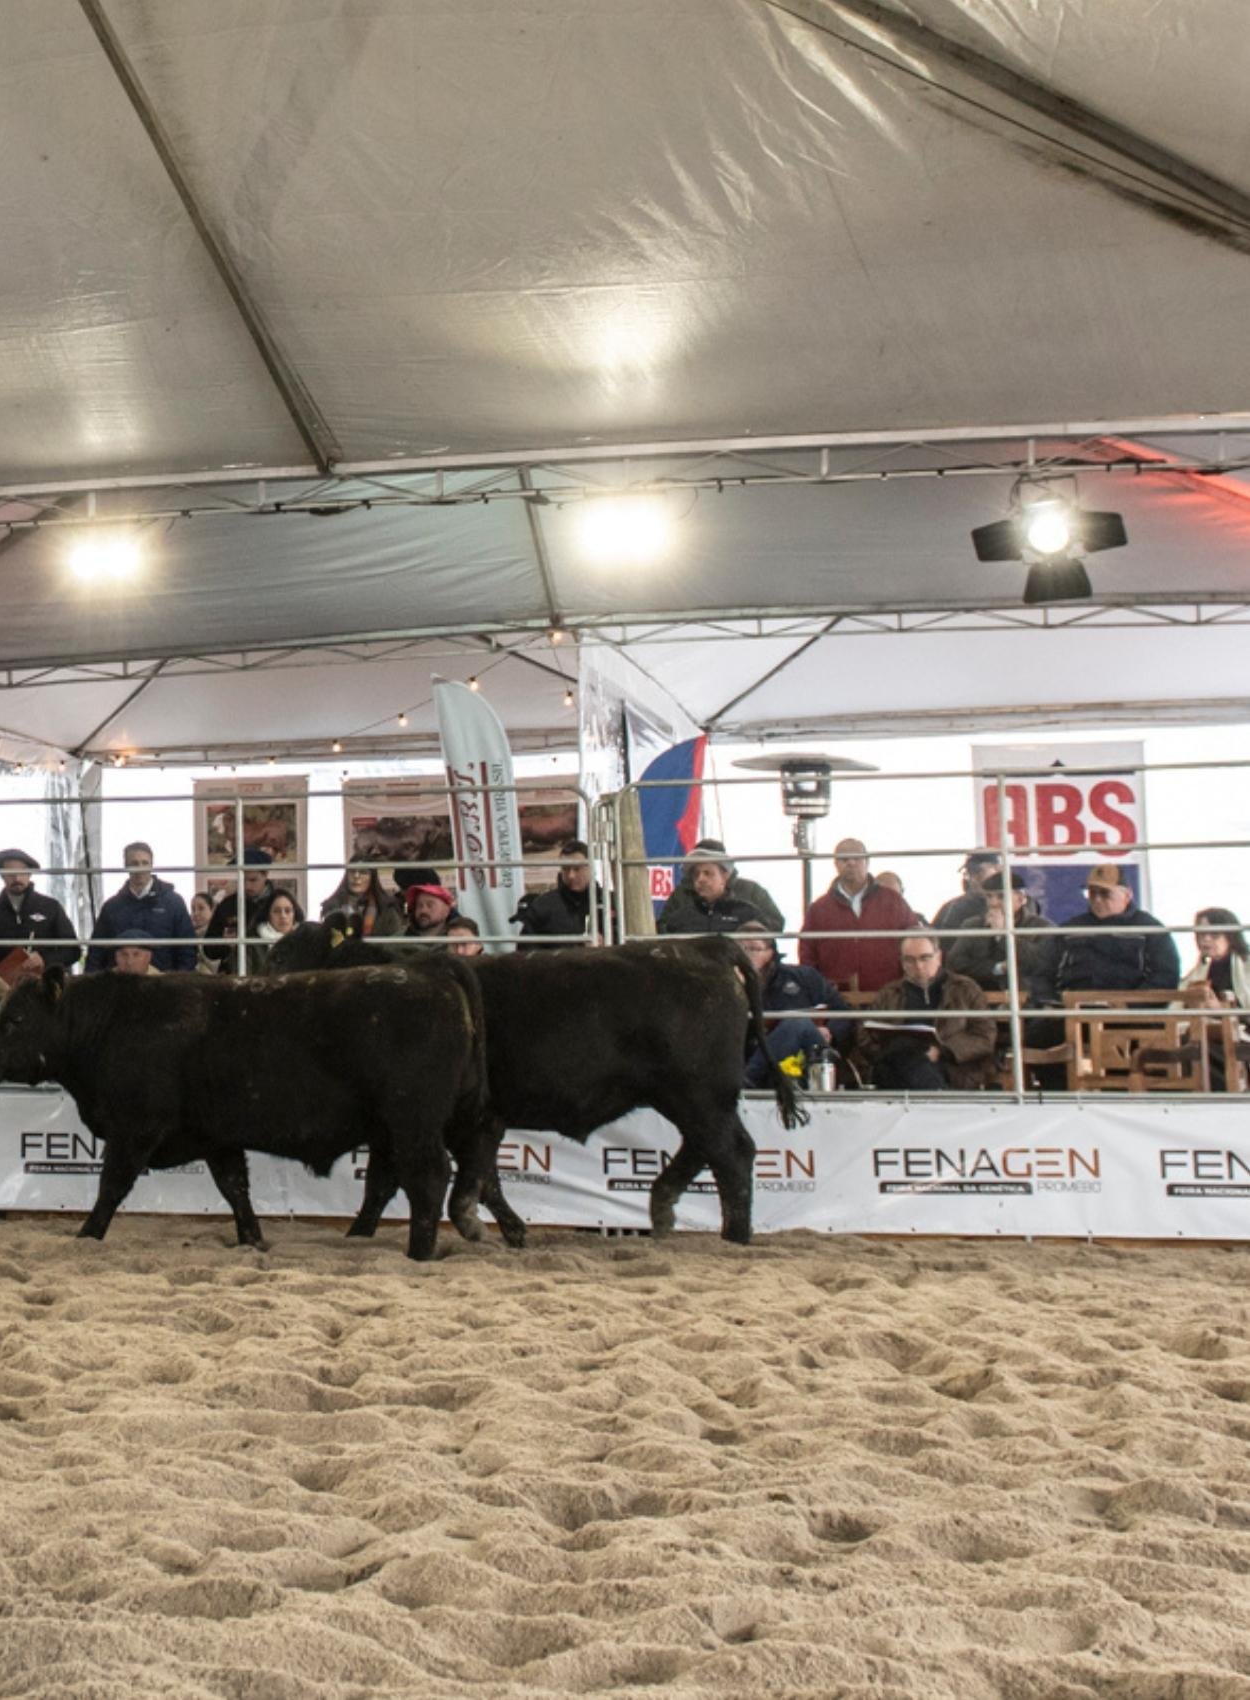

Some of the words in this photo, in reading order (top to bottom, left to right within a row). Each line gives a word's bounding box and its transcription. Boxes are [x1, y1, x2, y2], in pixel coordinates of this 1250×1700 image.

[983, 780, 1137, 858] ABS
[651, 867, 672, 897] BS
[21, 1133, 102, 1159] FEN
[872, 1148, 1101, 1179] FENAGEN
[1160, 1150, 1250, 1179] FEN
[914, 1184, 960, 1193] NACIONAL
[1037, 1181, 1102, 1193] PROMEBO
